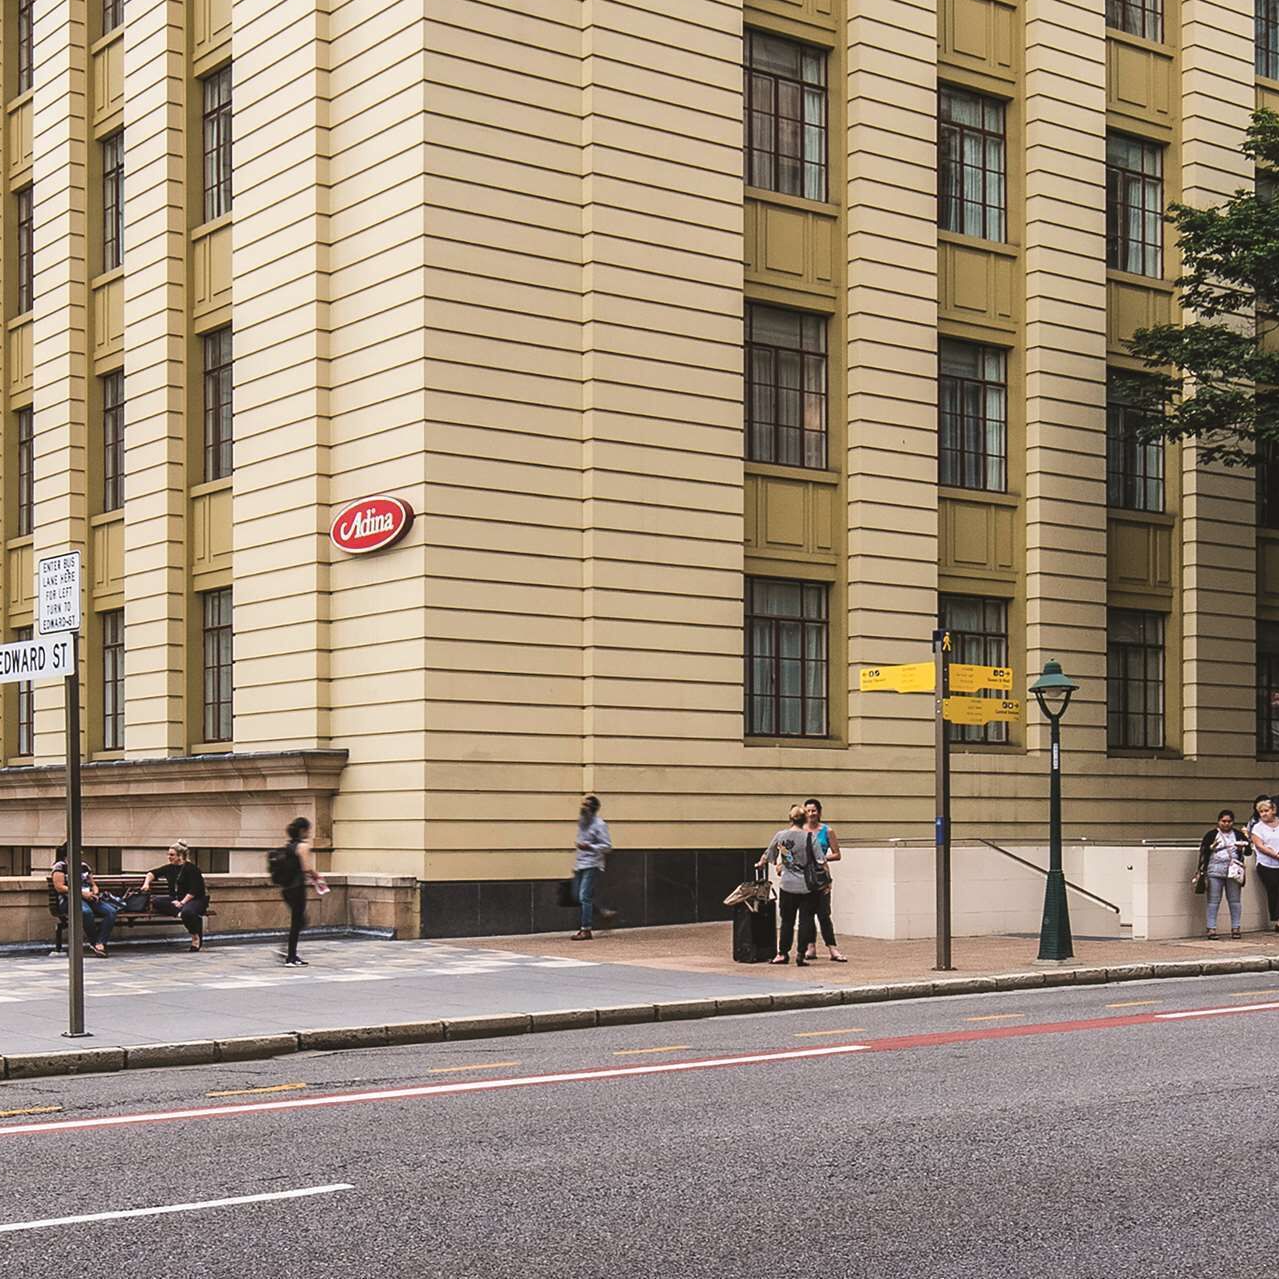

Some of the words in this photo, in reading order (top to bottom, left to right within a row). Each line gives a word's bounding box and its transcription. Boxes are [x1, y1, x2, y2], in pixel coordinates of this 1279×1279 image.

[340, 507, 394, 541] Adina
[43, 559, 61, 573] ENTER
[63, 556, 75, 569] BUS
[43, 575, 58, 588] LANE
[60, 571, 75, 584] HERE
[45, 589, 56, 601] FOR
[58, 586, 72, 599] LEFT
[46, 604, 61, 616] TURN
[64, 601, 71, 612] TO
[43, 617, 66, 631] EDWARD
[52, 643, 68, 669] ST
